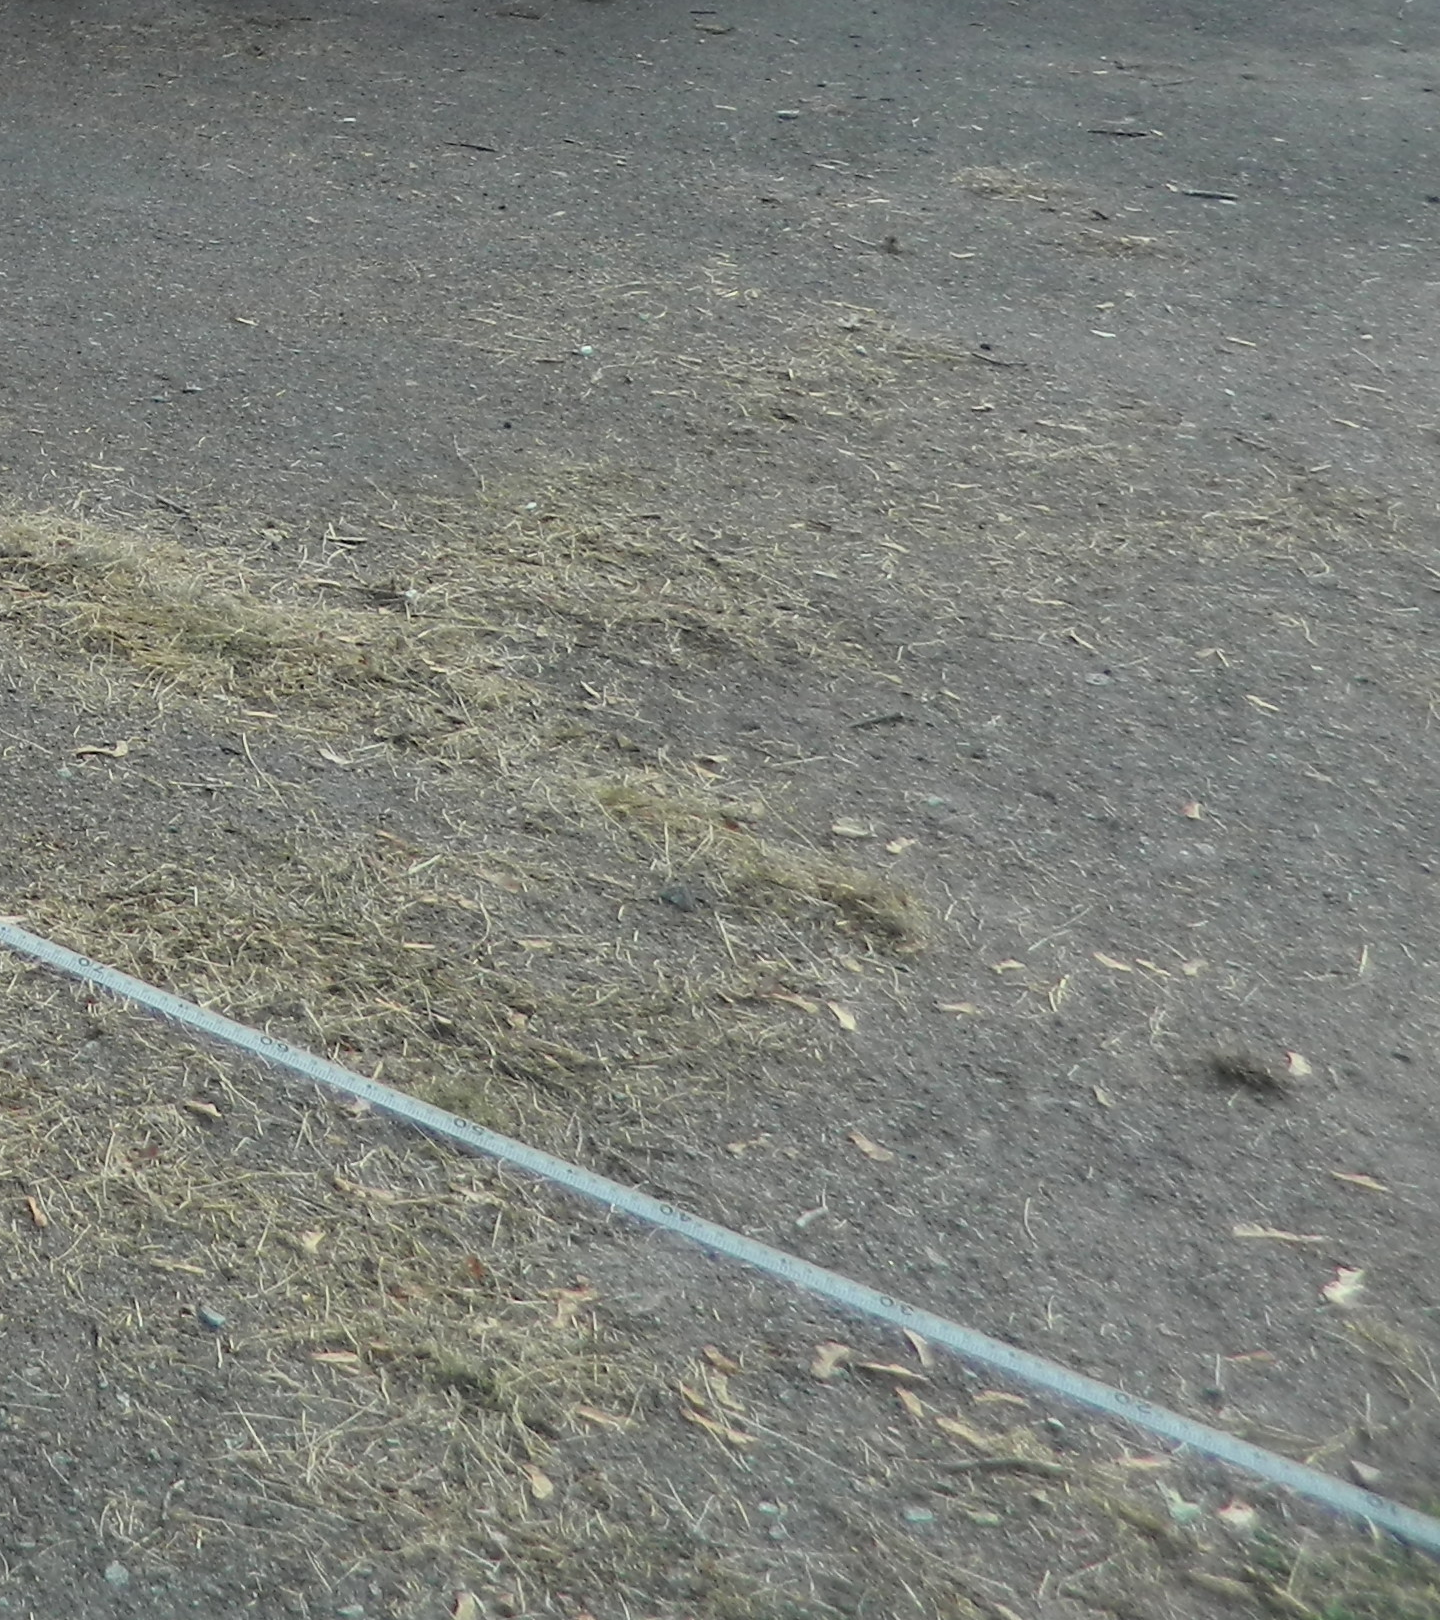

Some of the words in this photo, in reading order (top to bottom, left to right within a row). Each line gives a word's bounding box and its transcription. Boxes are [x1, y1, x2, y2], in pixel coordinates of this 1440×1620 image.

[77, 956, 105, 974] 70
[259, 1035, 288, 1053] 60
[452, 1116, 484, 1136] 50
[1113, 1391, 1152, 1414] 20
